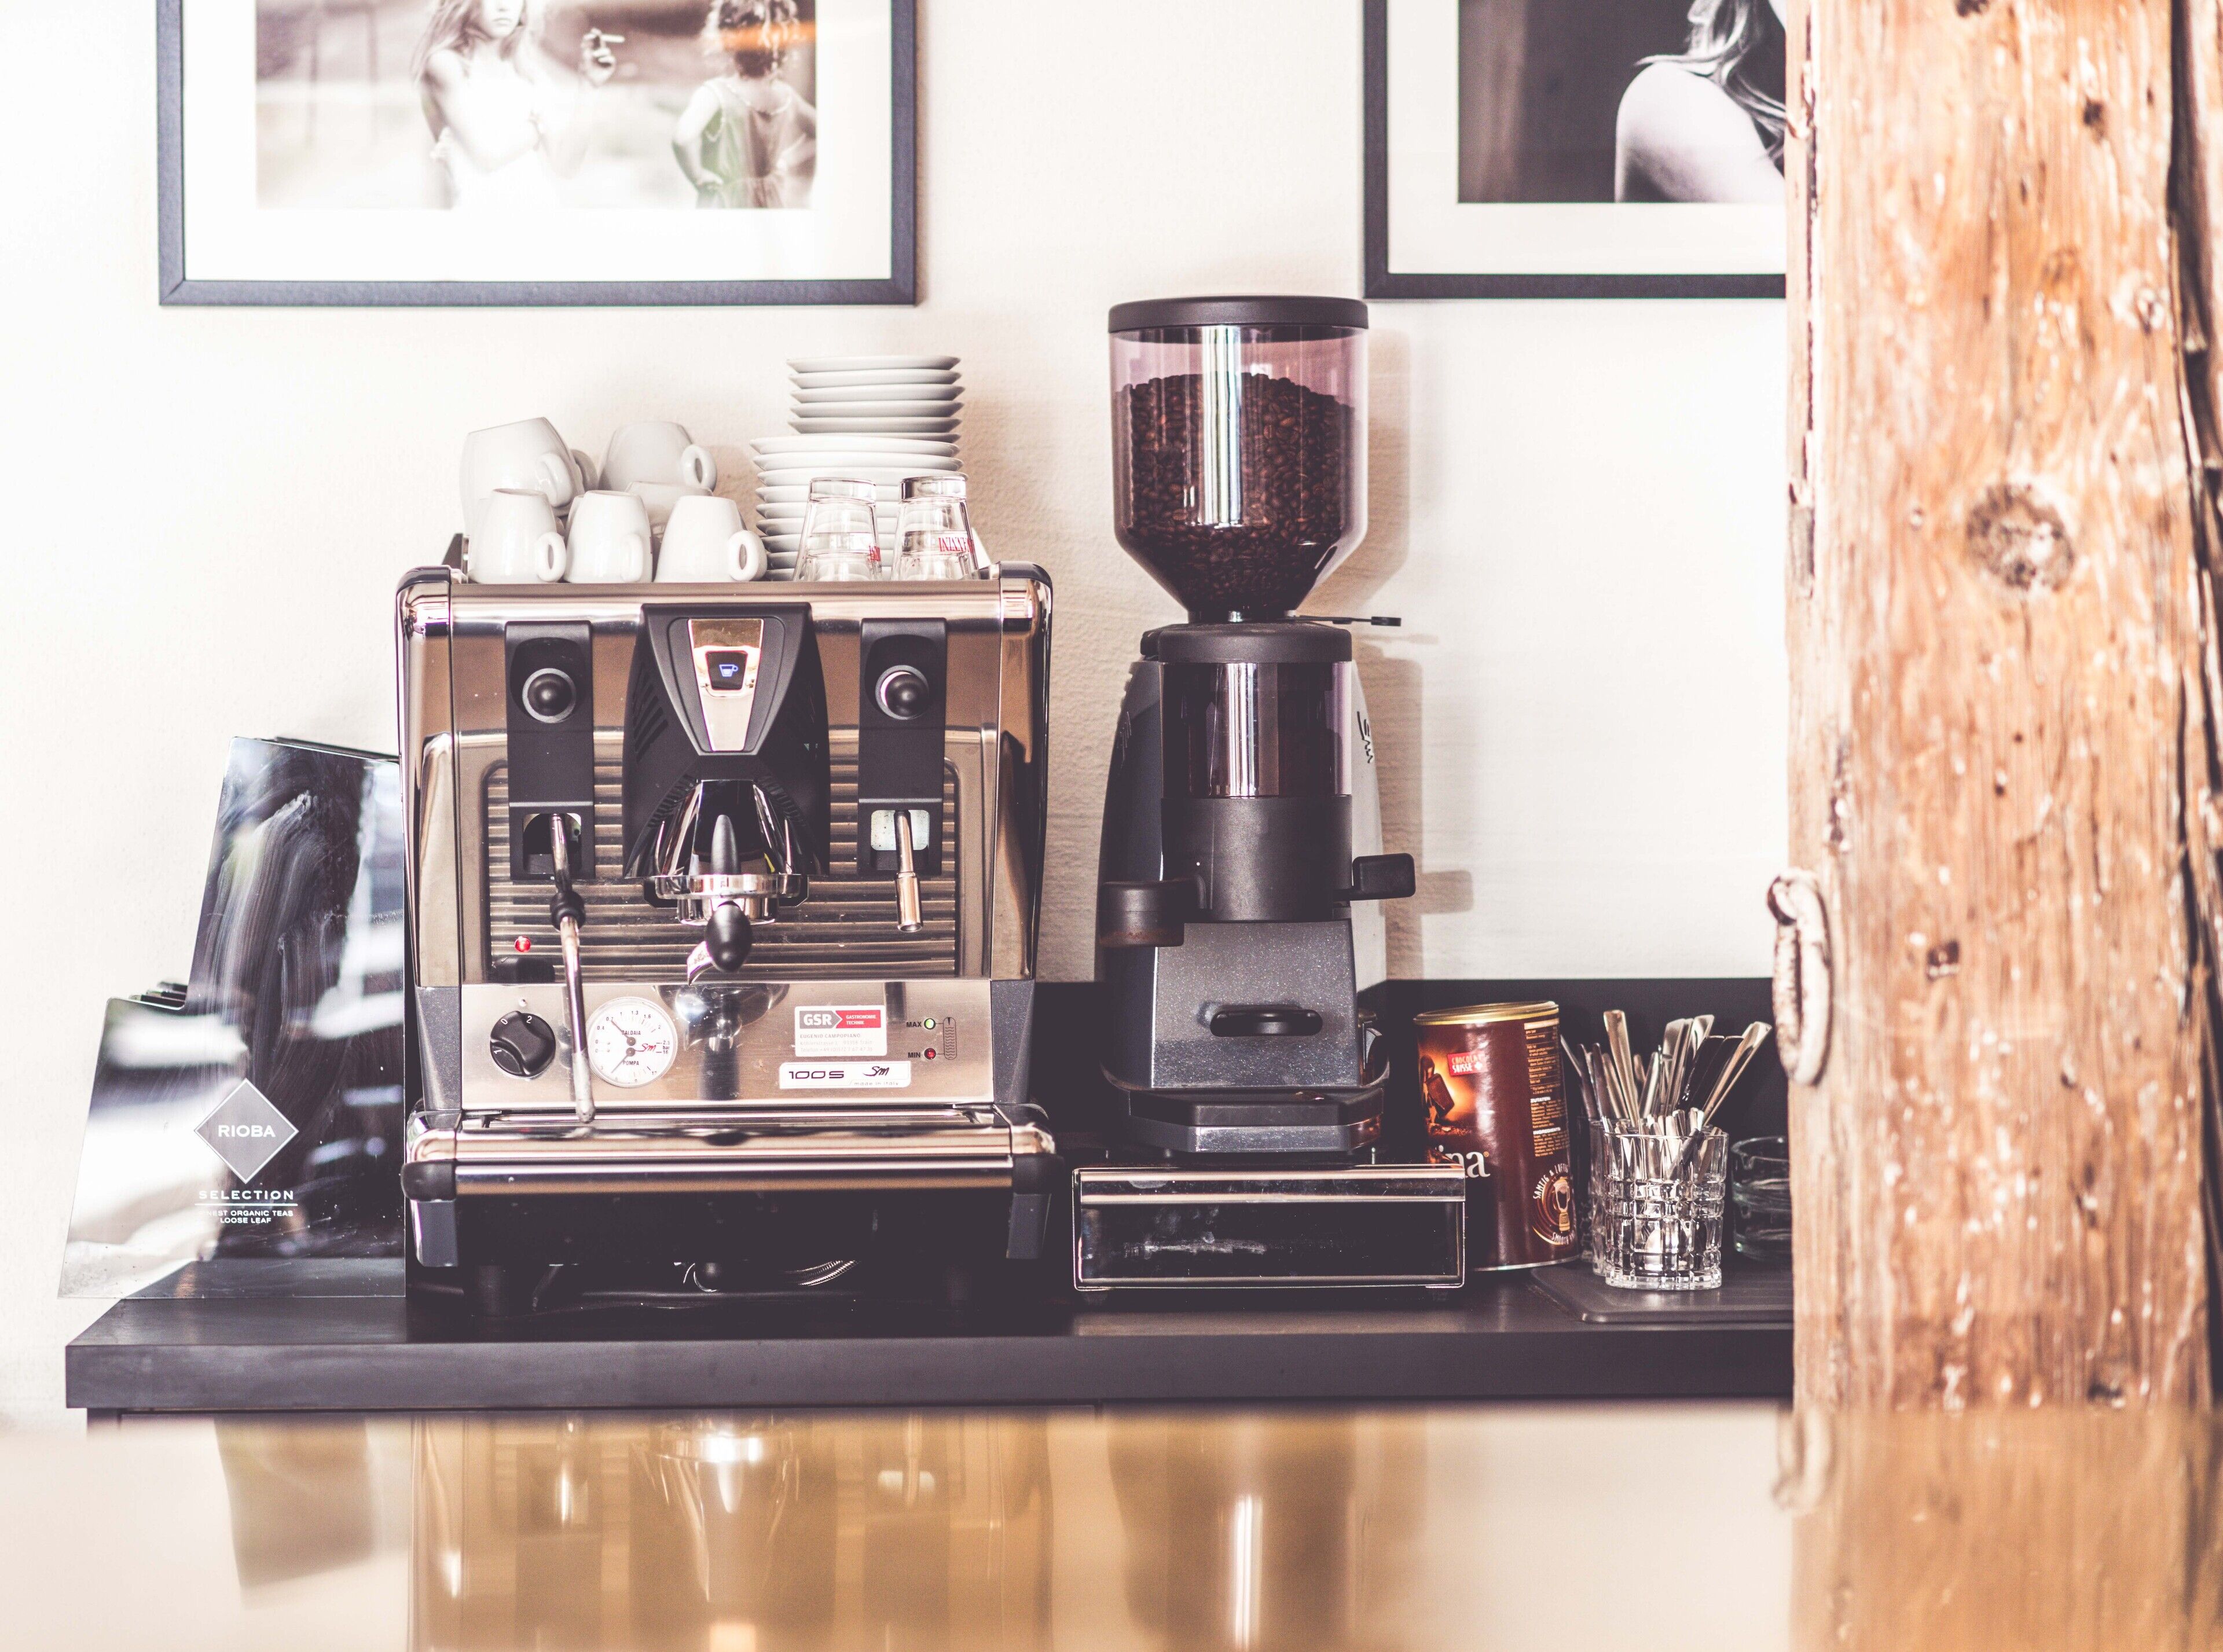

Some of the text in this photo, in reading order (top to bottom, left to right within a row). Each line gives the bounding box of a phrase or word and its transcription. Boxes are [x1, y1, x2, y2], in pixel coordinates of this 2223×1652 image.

[526, 1015, 533, 1024] 2
[804, 1014, 832, 1026] GSR
[218, 1125, 276, 1137] RIOBA
[199, 1190, 294, 1200] SELECTION
